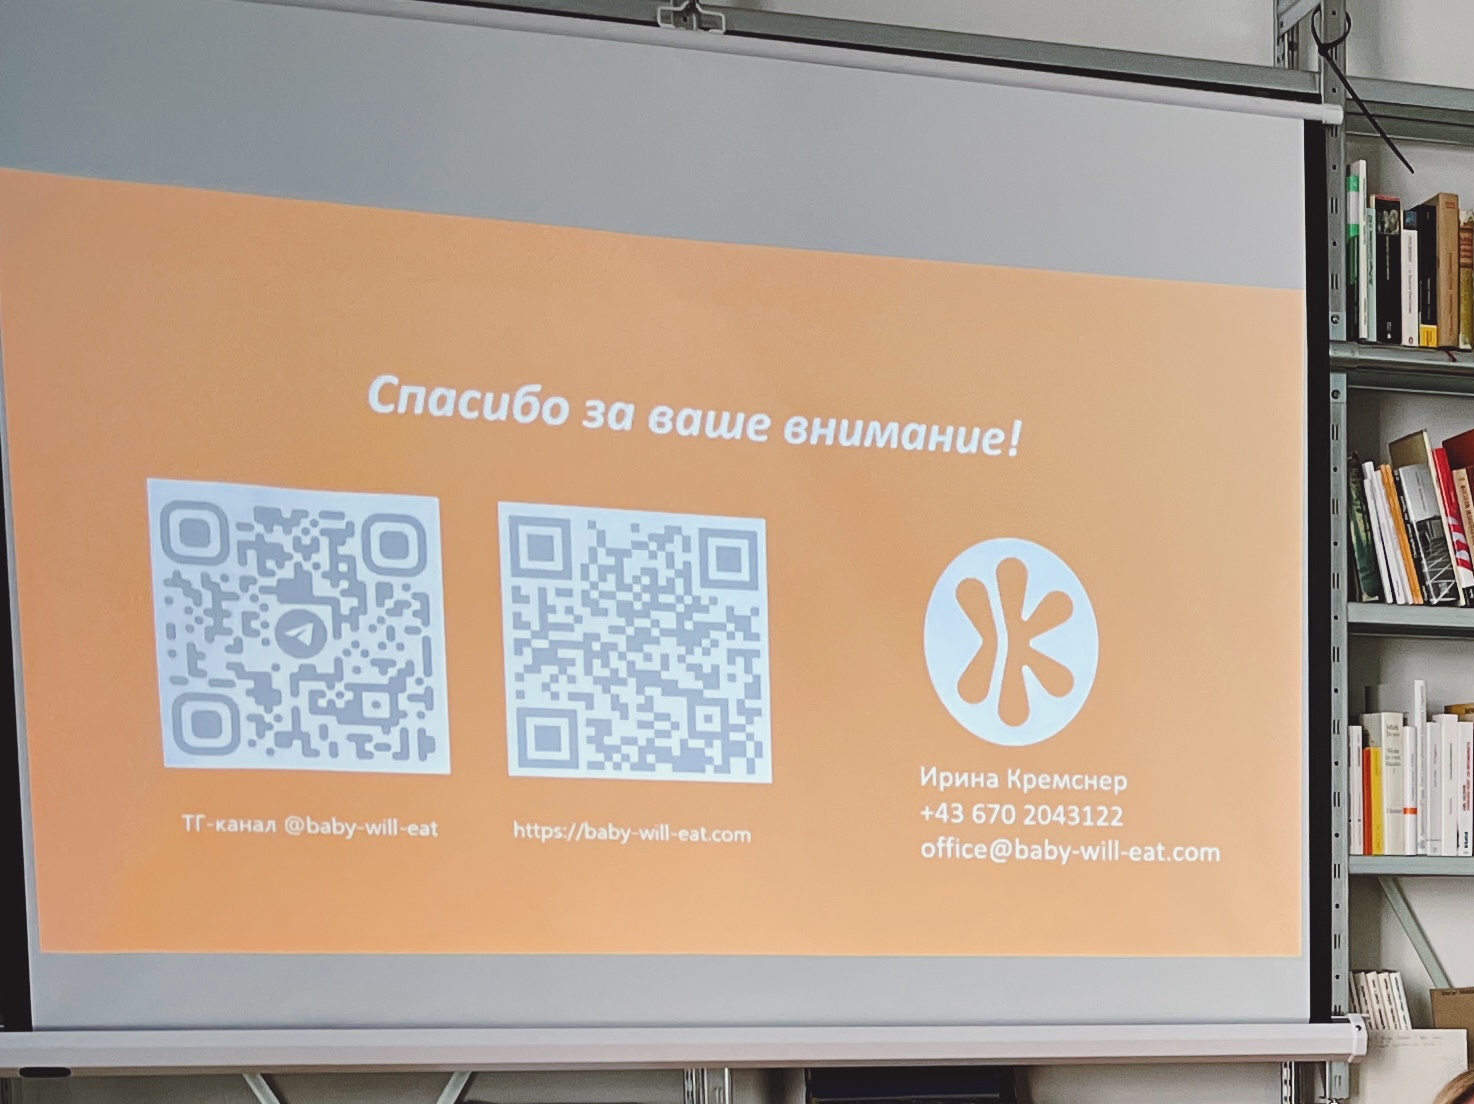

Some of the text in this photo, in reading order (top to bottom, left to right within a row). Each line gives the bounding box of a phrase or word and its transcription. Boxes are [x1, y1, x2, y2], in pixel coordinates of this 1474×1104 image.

[368, 374, 1022, 457] Спасибо за ваше внимание!
[920, 766, 1128, 795] Ирина Кремснер
[182, 814, 439, 840] ТГ-канал @baby-will-eat
[920, 802, 1124, 827] +43 670 2043122
[513, 820, 752, 845] https://baby-will-eat.com
[920, 836, 1220, 865] office@baby-will-eat.com
